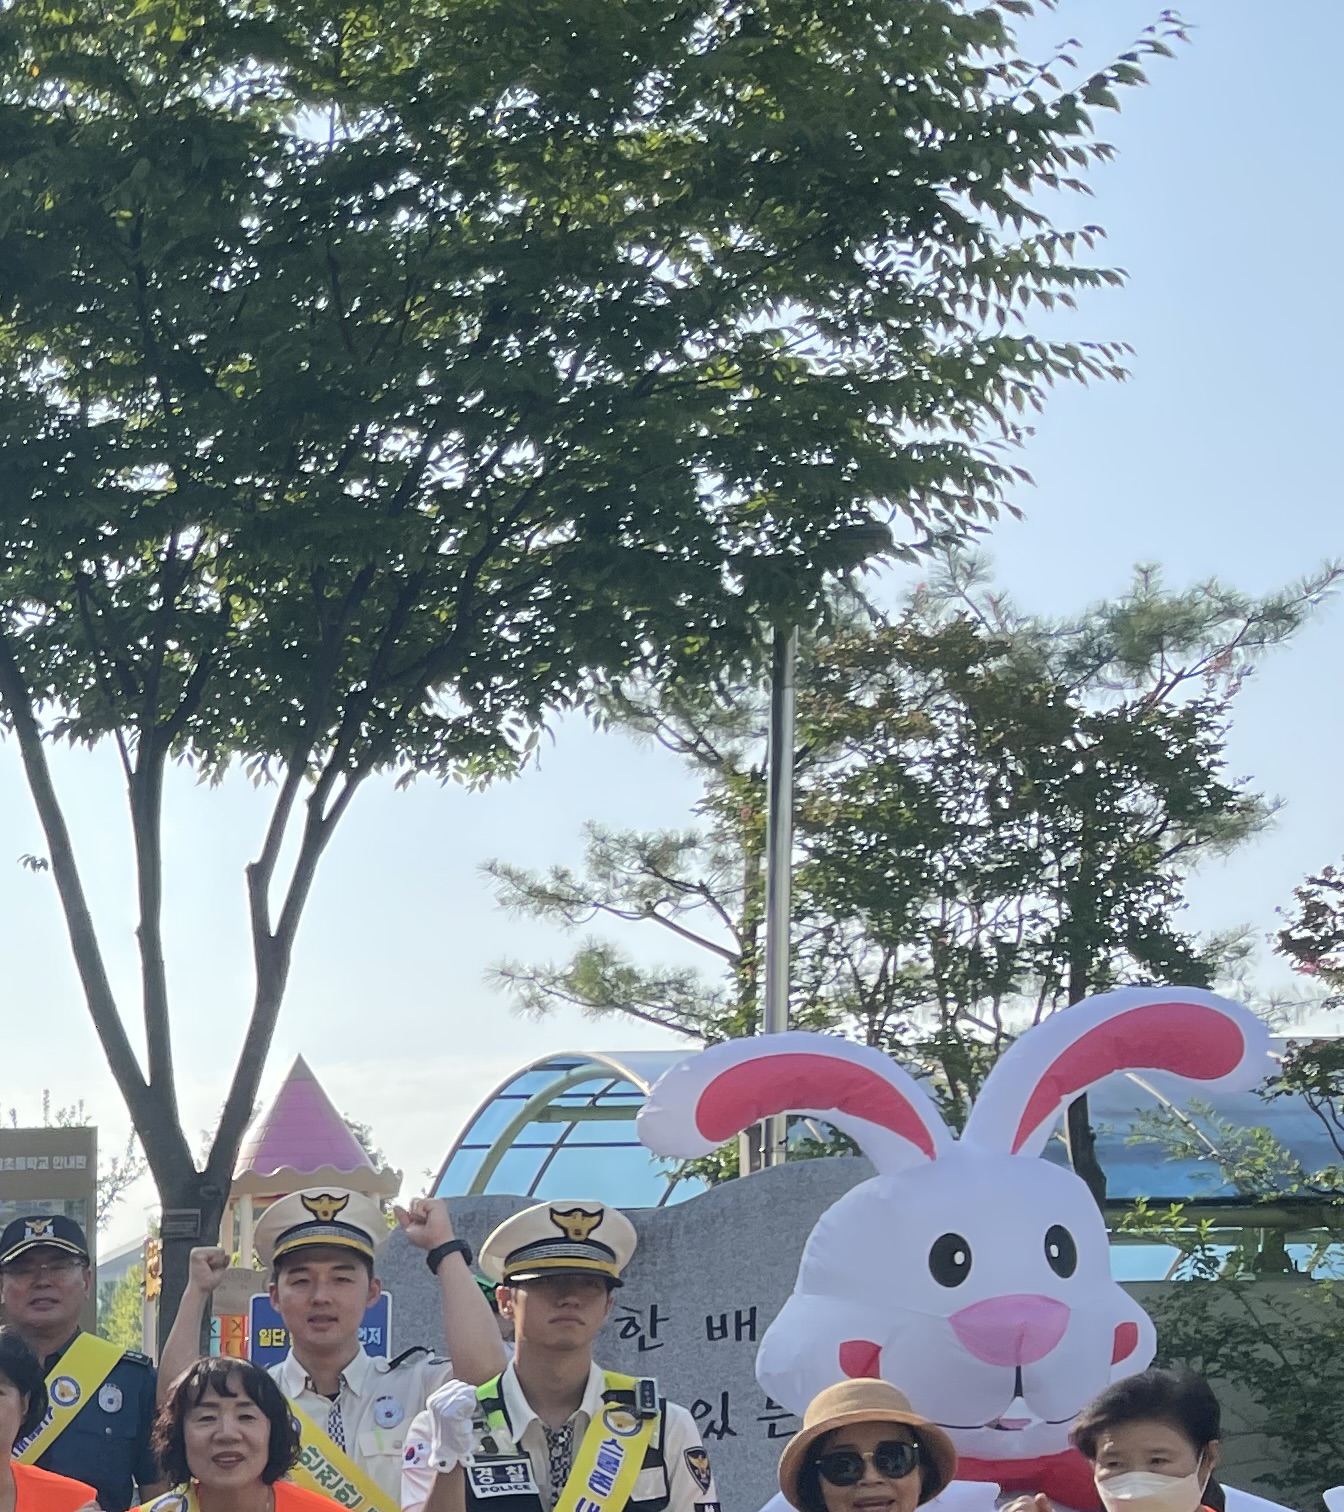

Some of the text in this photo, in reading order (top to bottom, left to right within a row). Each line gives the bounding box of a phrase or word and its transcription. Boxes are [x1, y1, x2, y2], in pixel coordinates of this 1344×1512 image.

[258, 1328, 286, 1346] 일단
[474, 1464, 525, 1485] 경찰
[587, 1437, 625, 1498] 스쿨존
[480, 1485, 532, 1494] POLICE
